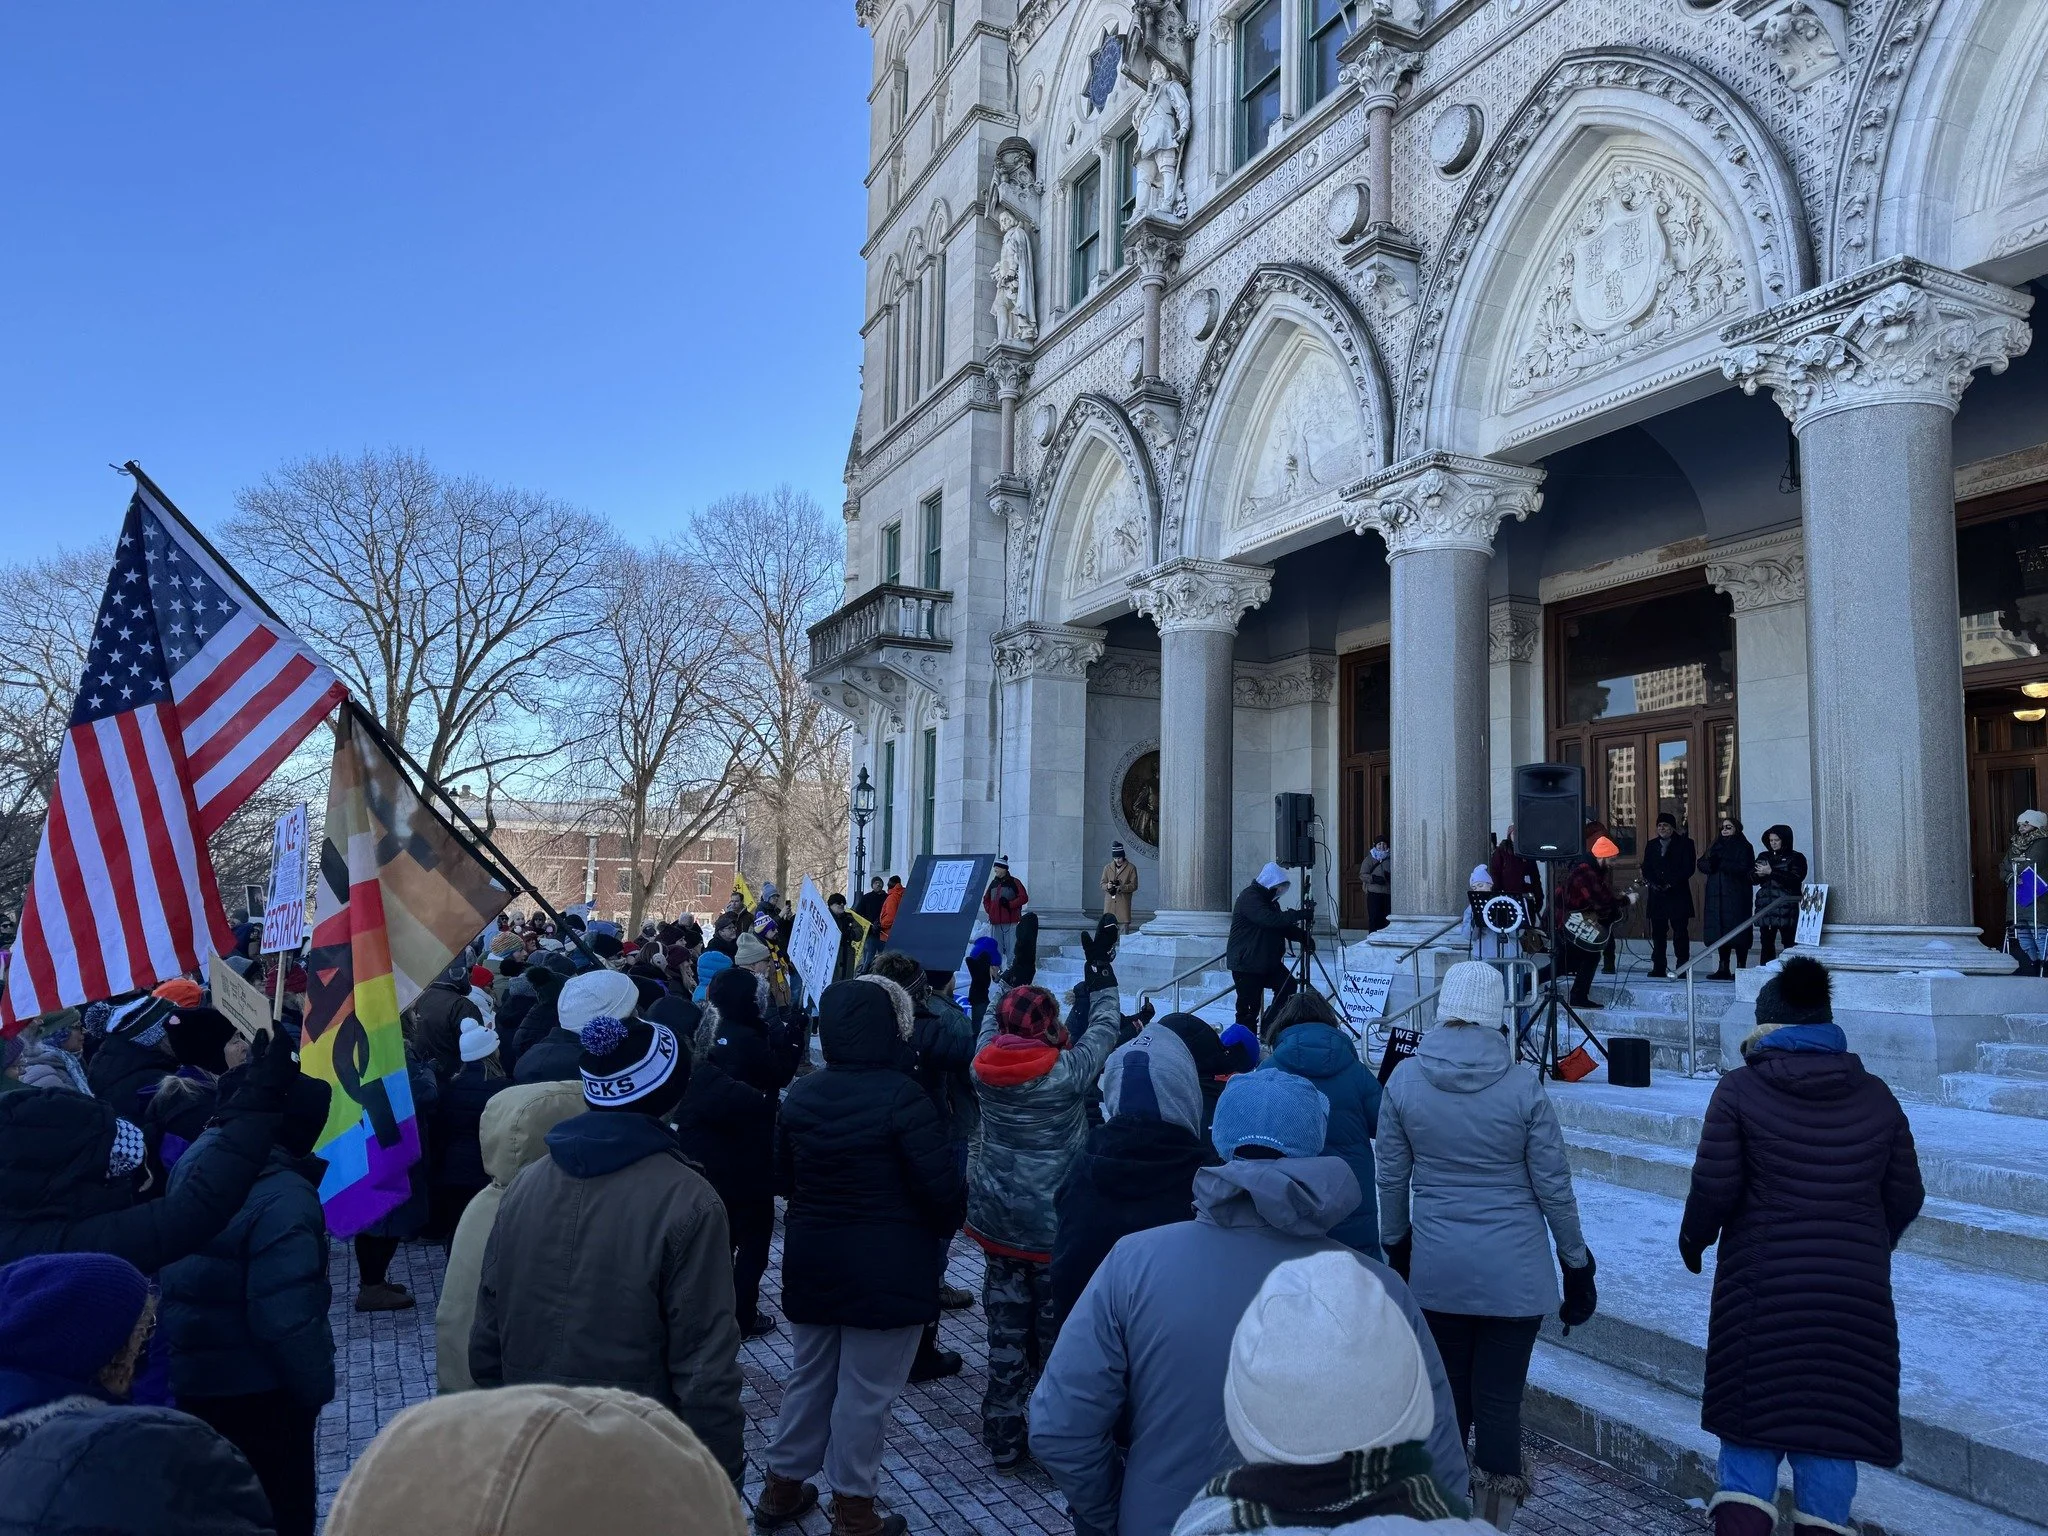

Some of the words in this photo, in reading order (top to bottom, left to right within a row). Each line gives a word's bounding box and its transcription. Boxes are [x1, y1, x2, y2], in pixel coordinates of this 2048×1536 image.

[931, 863, 973, 885] ICE
[926, 887, 966, 911] OUT
[262, 899, 303, 949] GESTAPO
[1362, 975, 1391, 986] America
[1343, 985, 1364, 993] Smart
[1365, 987, 1385, 997] Again
[1395, 1029, 1414, 1041] WE
[1395, 1043, 1418, 1055] HEA
